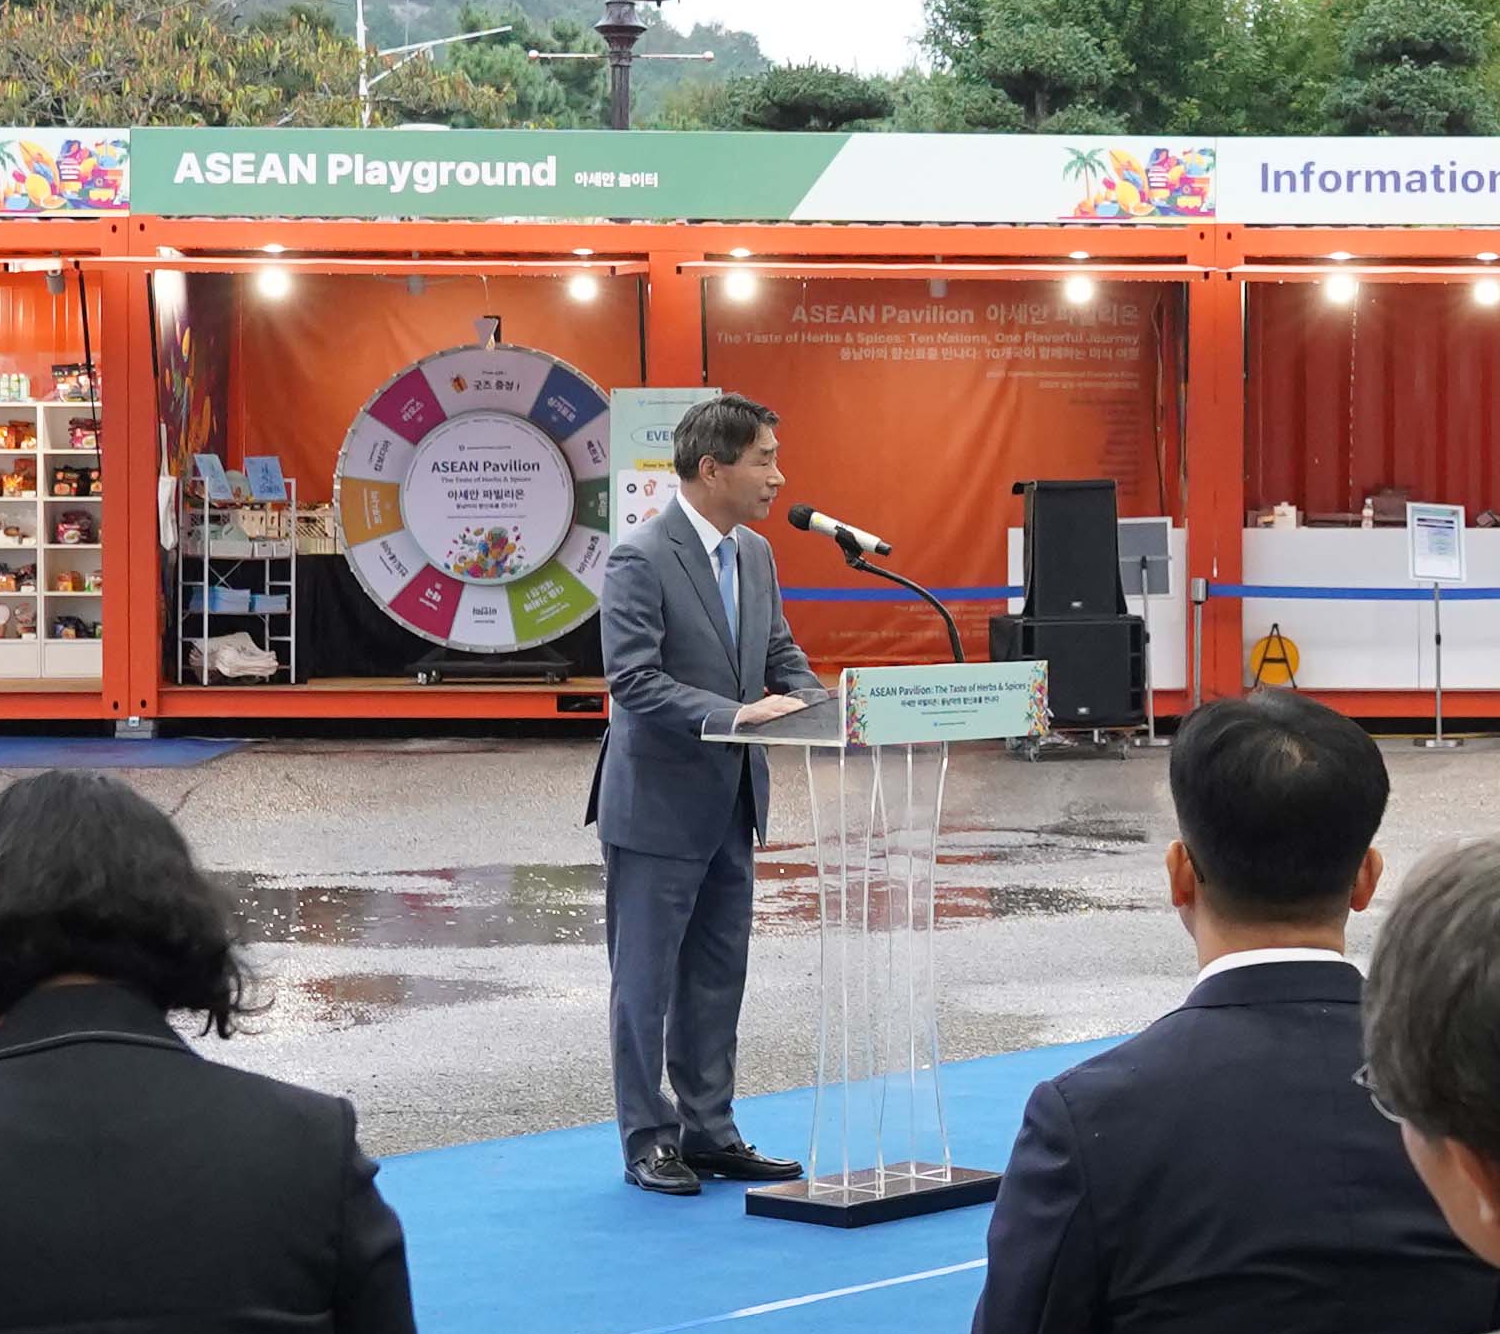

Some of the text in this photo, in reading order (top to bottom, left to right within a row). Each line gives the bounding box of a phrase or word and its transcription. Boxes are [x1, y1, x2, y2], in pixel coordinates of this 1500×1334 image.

[173, 152, 557, 194] ASEAN Playground
[574, 171, 659, 188] 아세안 놀이터
[792, 303, 974, 324] ASEAN Pavilion
[986, 304, 1048, 324] 아세안
[717, 331, 741, 344] The
[744, 331, 782, 344] Taste
[785, 331, 798, 344] of
[801, 331, 841, 344] Herbs
[843, 332, 853, 344] &
[910, 332, 933, 344] Ten
[995, 332, 1021, 344] One
[1025, 331, 1083, 344] Flavorful
[431, 459, 540, 473] ASEAN Pavilion
[447, 488, 525, 500] 아세안 파빌리온
[869, 681, 1026, 698] ASEAN Pavilion: The Taste of Herbs & Spices
